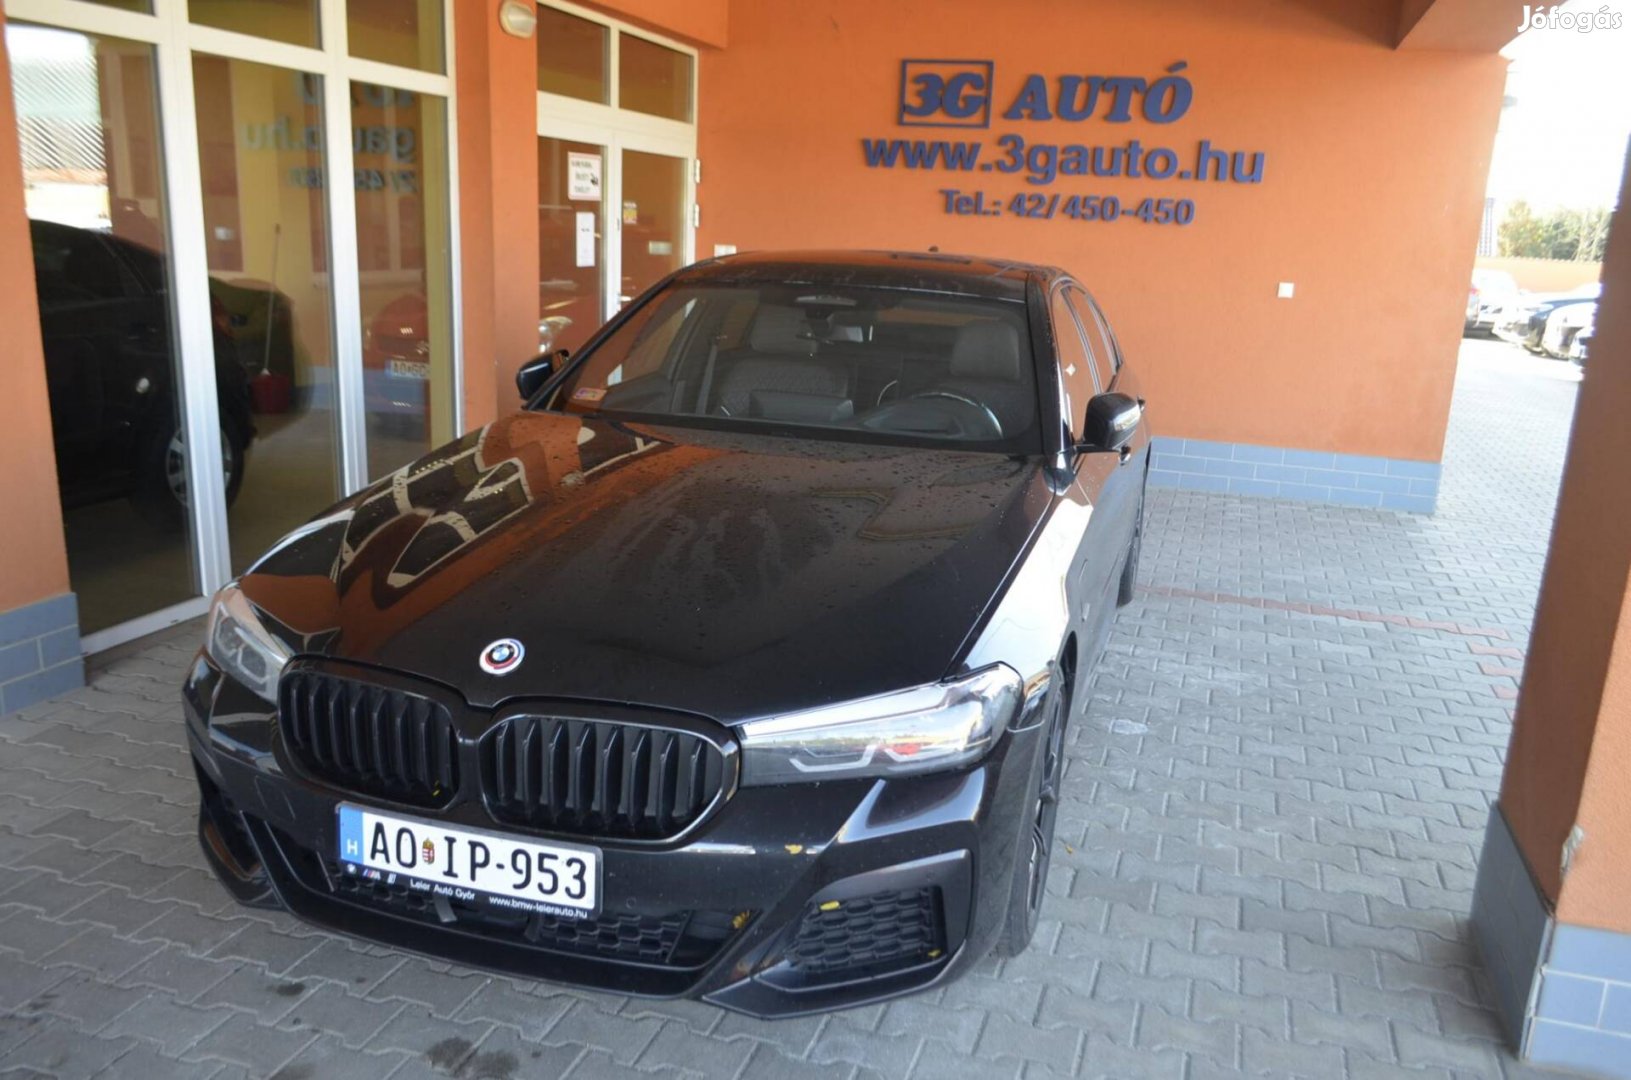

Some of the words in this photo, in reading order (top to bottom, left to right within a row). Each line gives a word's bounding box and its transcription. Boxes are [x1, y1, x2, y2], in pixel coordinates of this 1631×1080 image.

[903, 72, 987, 119] 3G
[1002, 61, 1193, 124] AUTÓ
[862, 133, 1266, 185] www.3gauto.hu
[939, 188, 1003, 217] Tel.:
[347, 838, 358, 856] H
[370, 821, 418, 869] AO
[443, 835, 588, 901] IP-953
[410, 878, 431, 892] Leier
[488, 895, 588, 919] www.bmw-leierauto.hu
